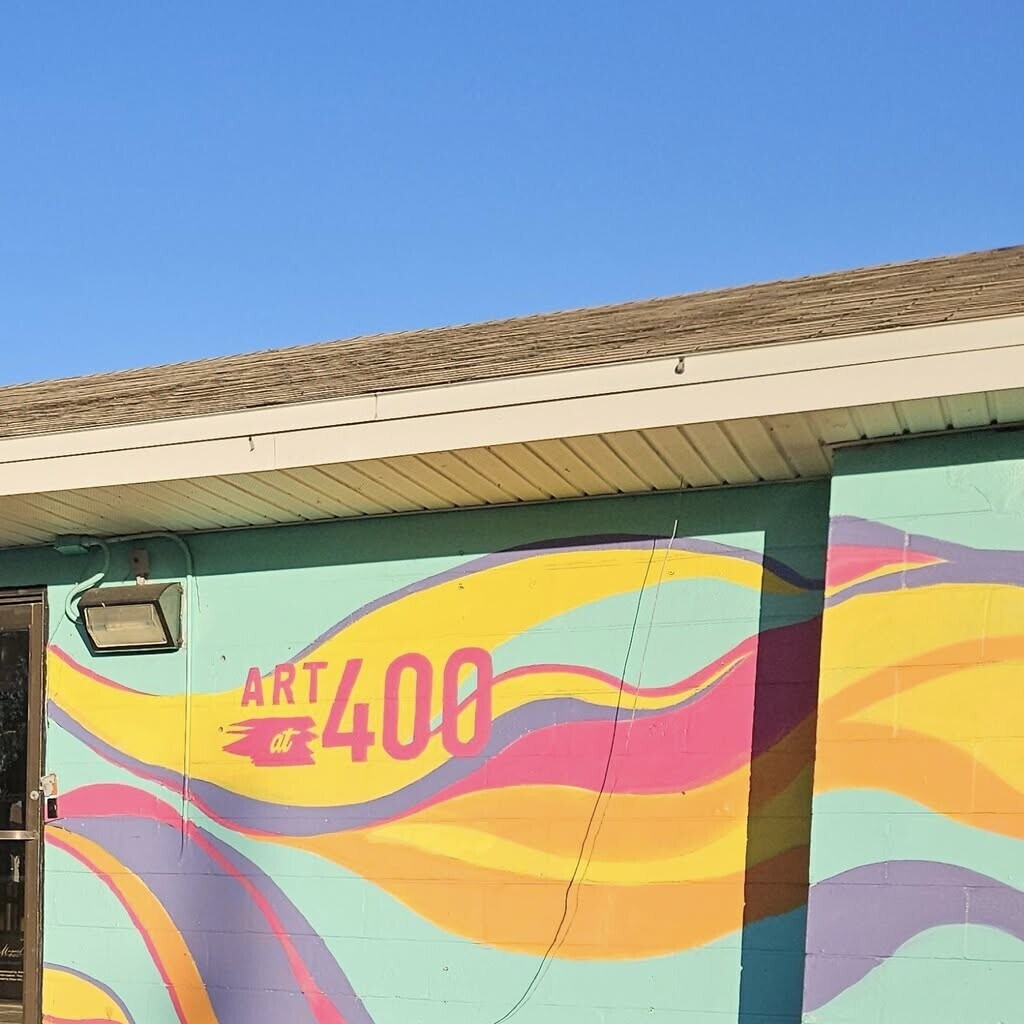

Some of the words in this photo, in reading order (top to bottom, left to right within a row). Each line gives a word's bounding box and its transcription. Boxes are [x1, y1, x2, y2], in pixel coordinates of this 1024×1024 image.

[241, 661, 328, 707] ART
[322, 646, 493, 763] 400
[269, 727, 300, 754] at
